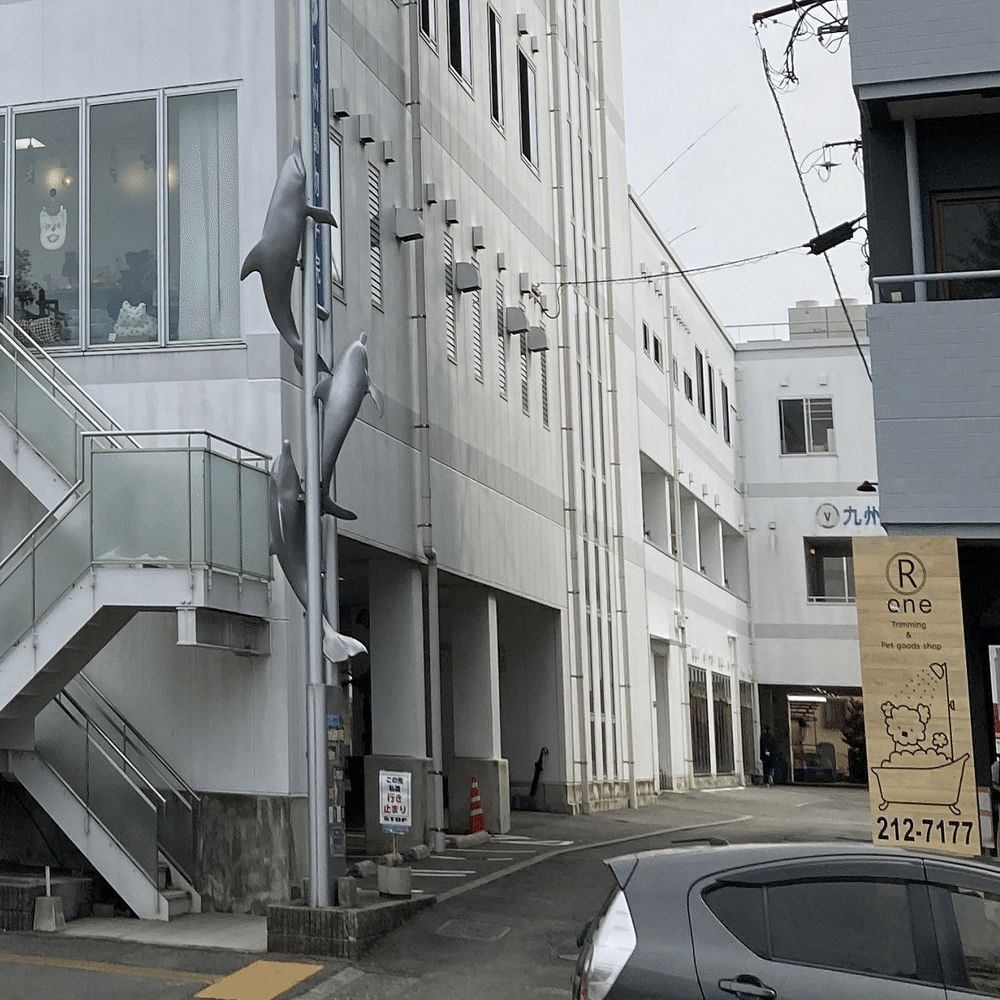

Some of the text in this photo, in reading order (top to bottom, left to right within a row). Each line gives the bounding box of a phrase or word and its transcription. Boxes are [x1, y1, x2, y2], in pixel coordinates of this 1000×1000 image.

[843, 505, 881, 526] 九州
[891, 620, 927, 631] Trimming
[906, 631, 912, 639] &
[881, 641, 942, 651] Pet goods shop
[387, 793, 402, 803] 行き
[383, 804, 406, 815] 止まり
[383, 815, 408, 823] STOP
[877, 816, 973, 846] 212-7177
